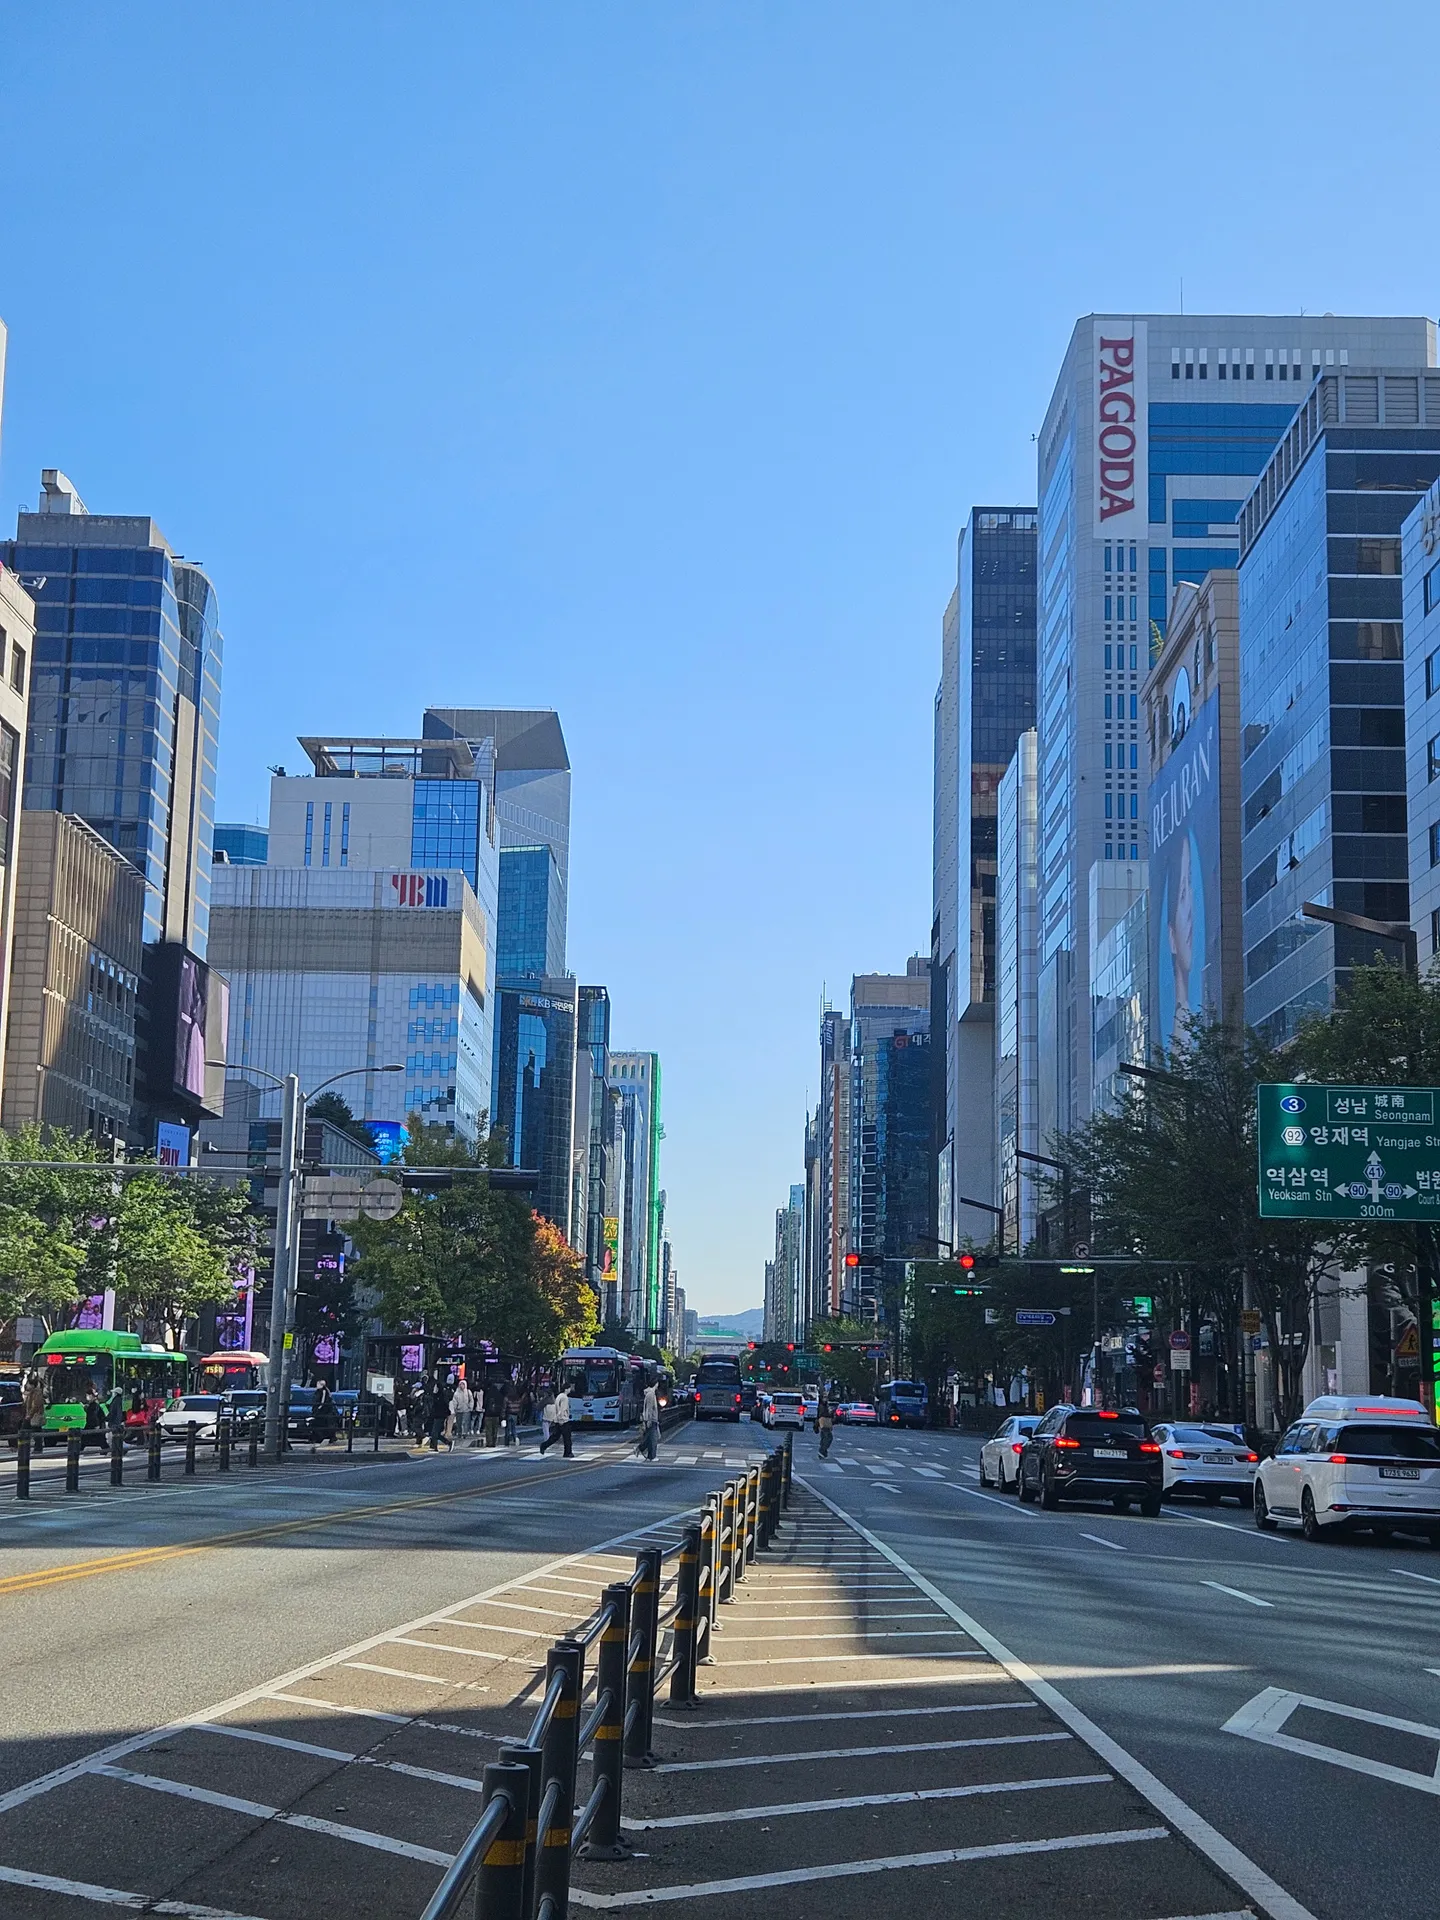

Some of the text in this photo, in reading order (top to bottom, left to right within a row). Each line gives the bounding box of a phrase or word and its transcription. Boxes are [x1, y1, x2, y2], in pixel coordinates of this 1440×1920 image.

[1099, 336, 1136, 523] PAGODA
[1153, 739, 1211, 854] REJURAN
[391, 874, 448, 907] YBM
[1288, 1098, 1299, 1111] 3
[1334, 1097, 1367, 1115] 성남
[1374, 1109, 1431, 1122] Seongnam
[1287, 1130, 1301, 1142] 92
[1310, 1126, 1369, 1147] 양재역
[1376, 1136, 1421, 1150] Yangjae
[1266, 1167, 1329, 1187] 역삼역
[1368, 1167, 1381, 1178] 41
[1268, 1188, 1332, 1202] Yeoksam Stn
[1352, 1185, 1364, 1196] 90
[1387, 1186, 1399, 1197] 90
[1360, 1205, 1395, 1217] 300m
